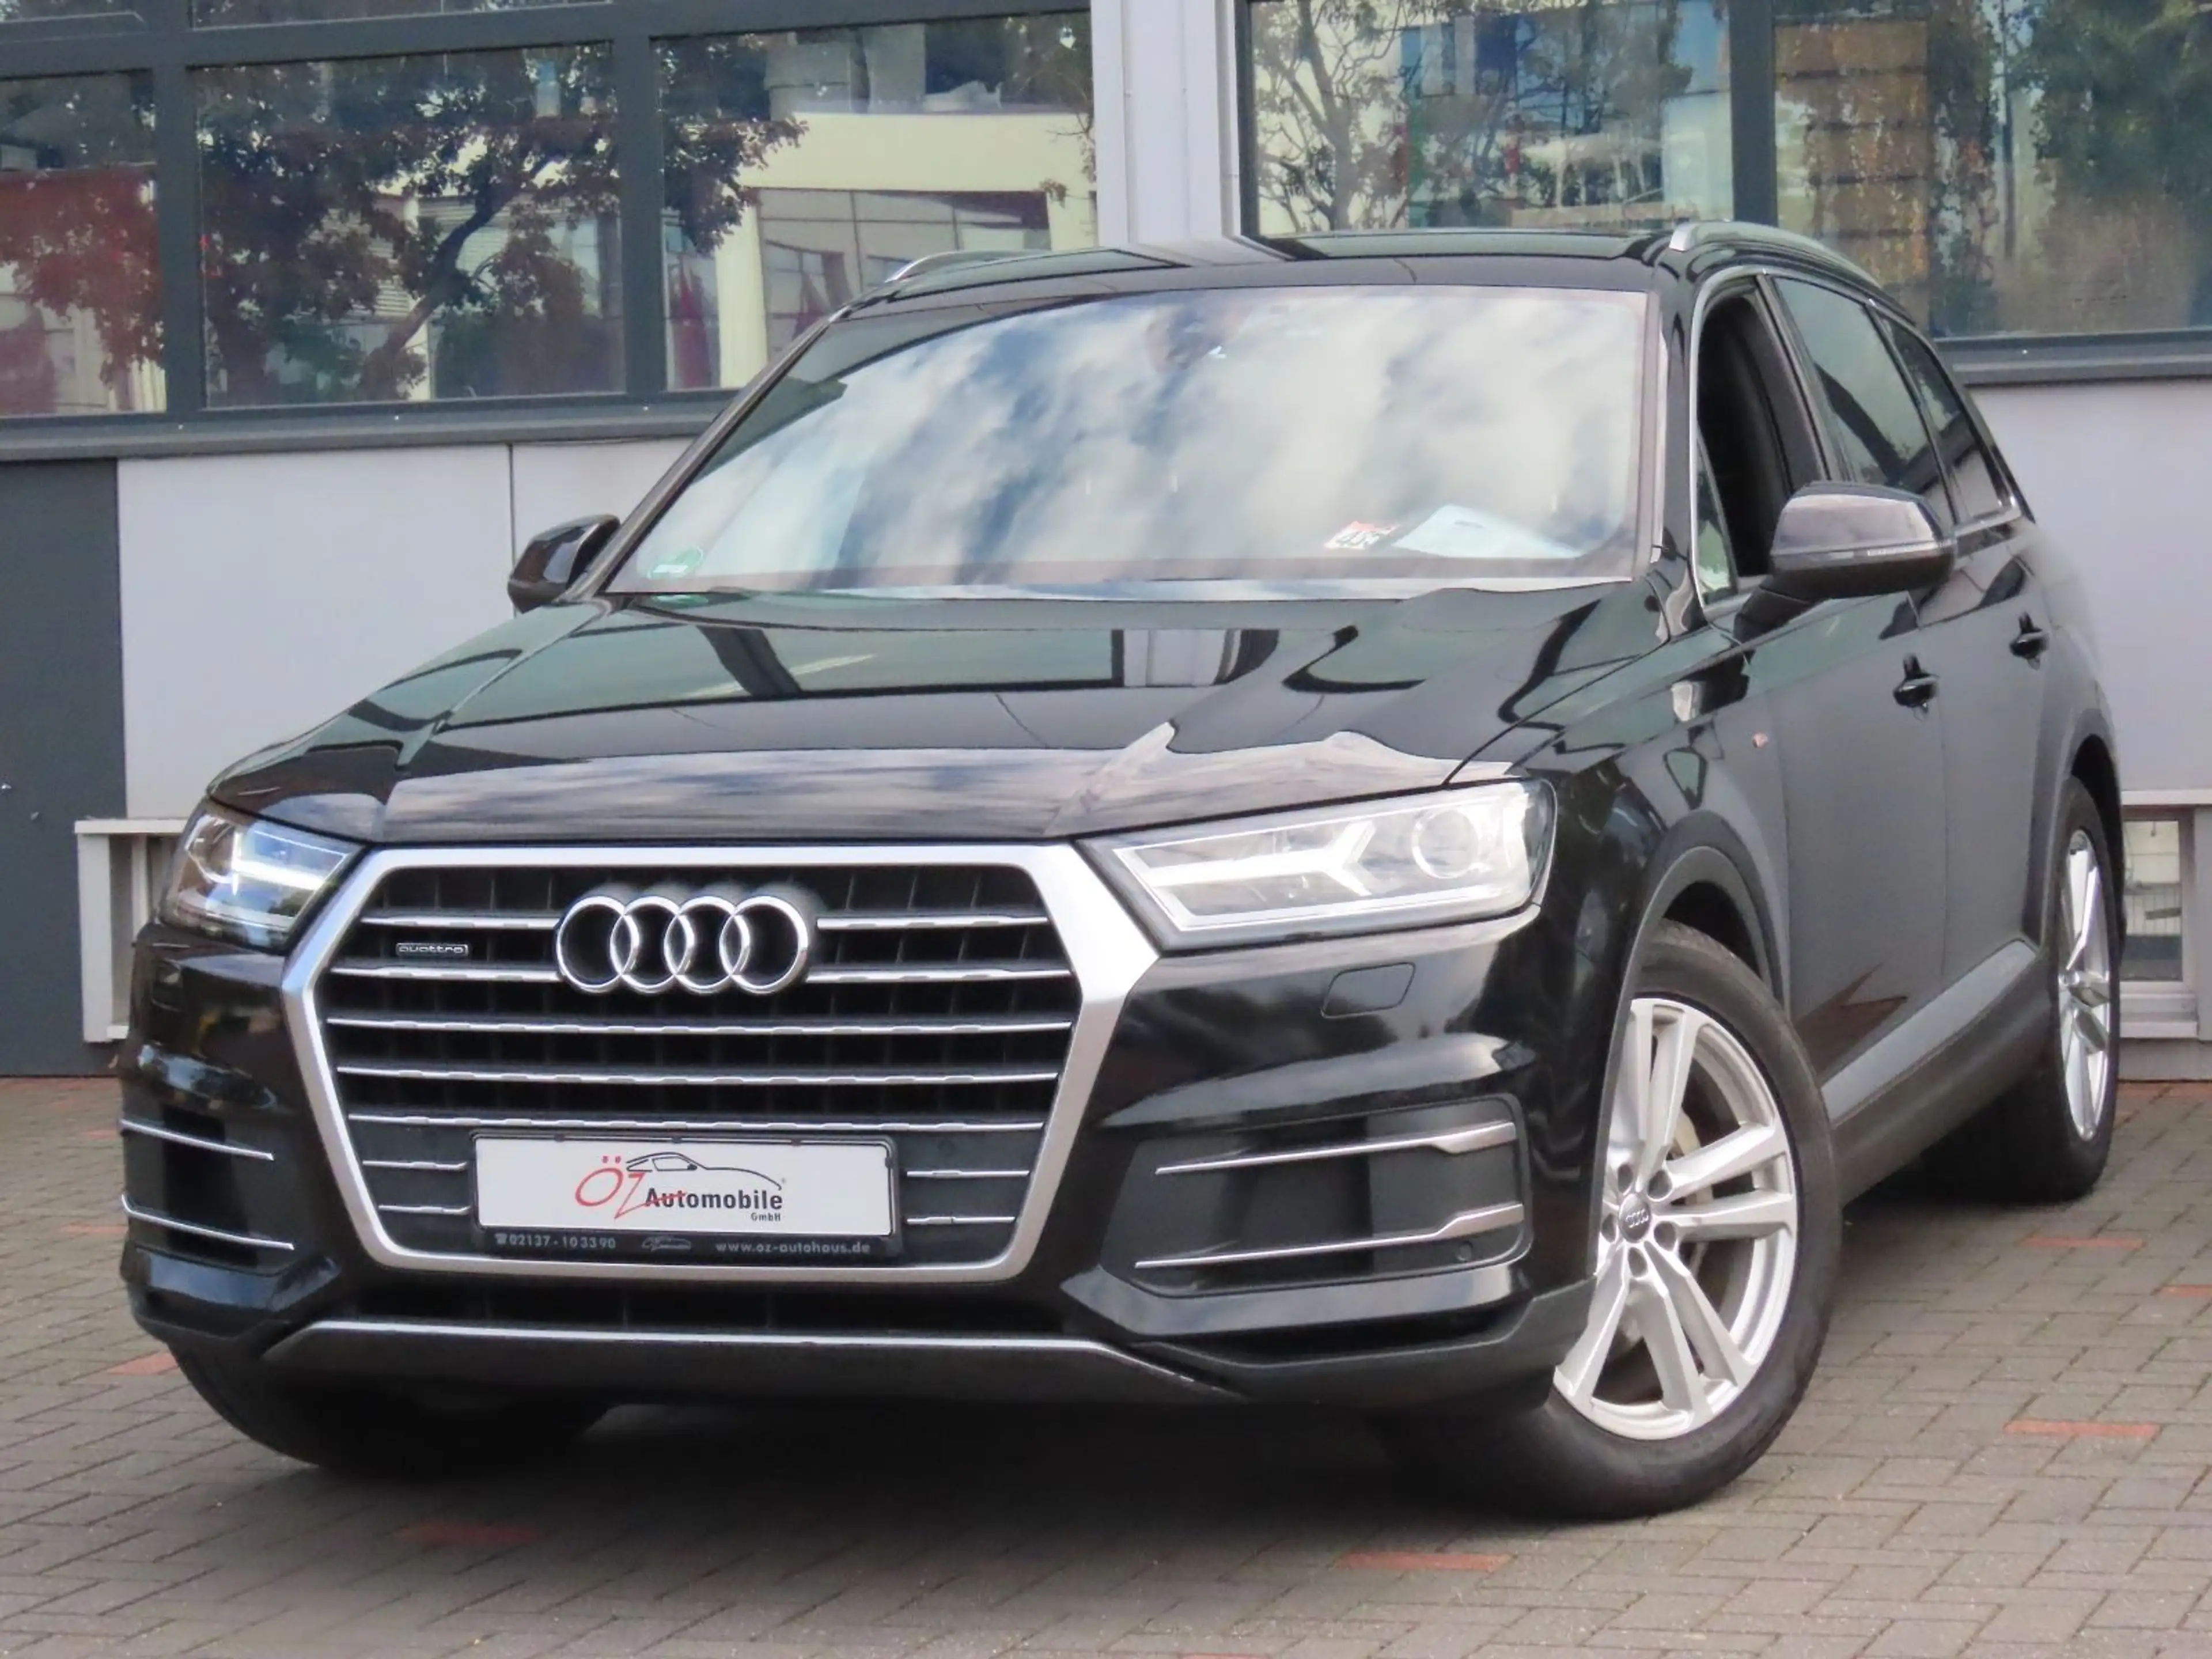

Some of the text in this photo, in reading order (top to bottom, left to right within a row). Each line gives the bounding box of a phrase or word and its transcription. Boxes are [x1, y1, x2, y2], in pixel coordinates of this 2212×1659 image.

[398, 945, 464, 954] quattro
[575, 1155, 783, 1219] ÖZ Automobile
[750, 1213, 781, 1222] GmbH
[715, 1241, 871, 1255] www.oz-autohaus.de
